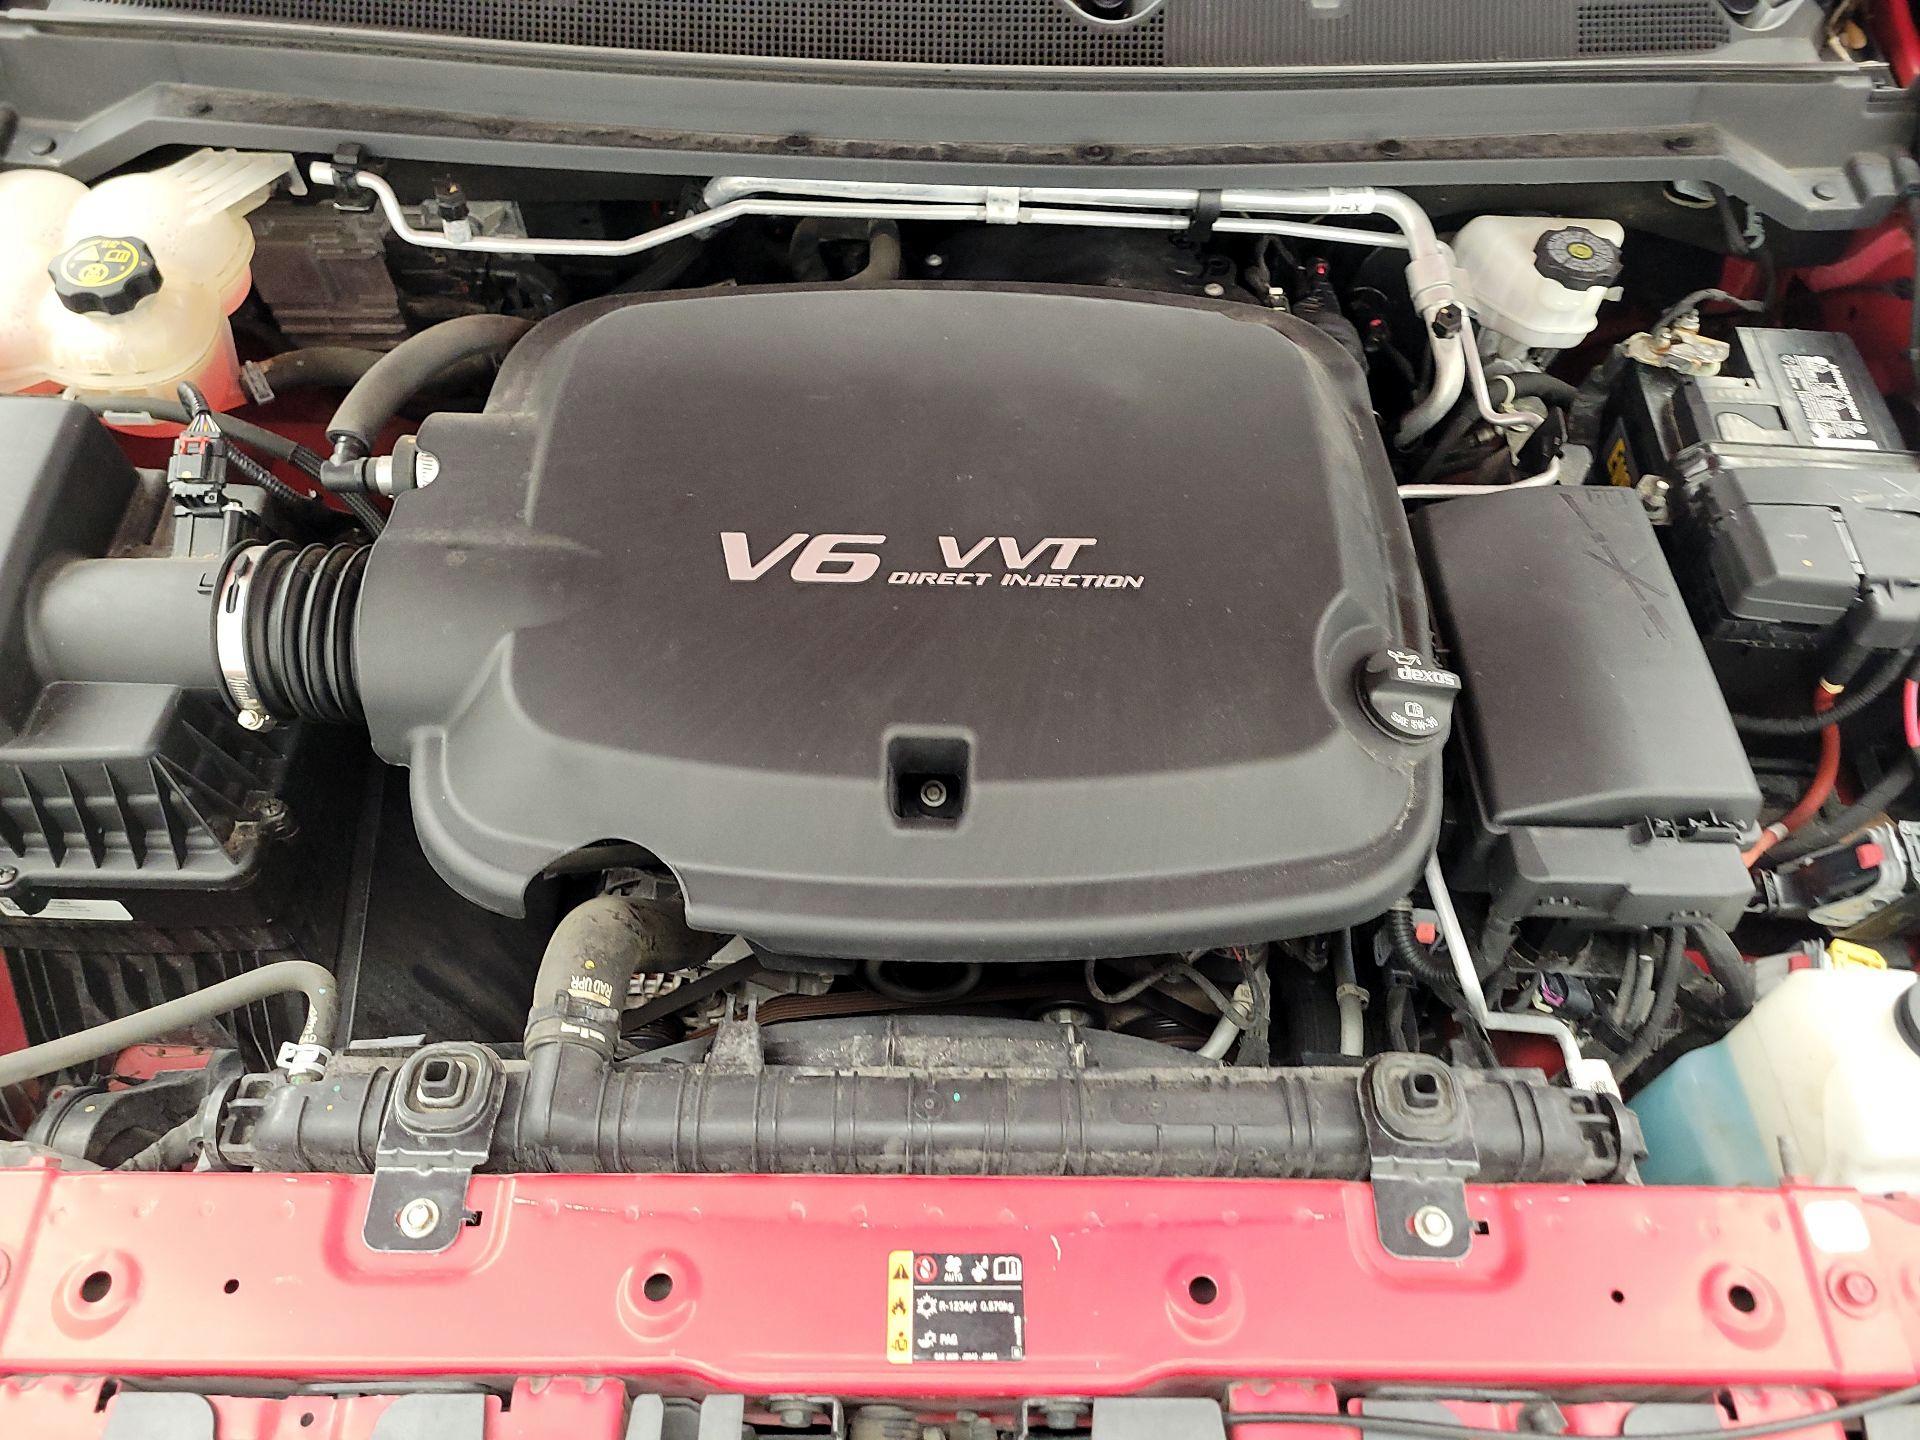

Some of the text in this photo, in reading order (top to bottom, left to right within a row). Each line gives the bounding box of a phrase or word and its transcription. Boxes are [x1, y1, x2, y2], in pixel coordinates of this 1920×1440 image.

[720, 532, 887, 583] V6
[938, 535, 1098, 569] VVT
[887, 571, 1145, 588] DIRECT INJECTION
[1397, 665, 1455, 686] dexos
[1390, 711, 1439, 731] SAE 5W-30
[570, 974, 613, 1000] RAD UPR
[944, 1272, 963, 1282] AUTO
